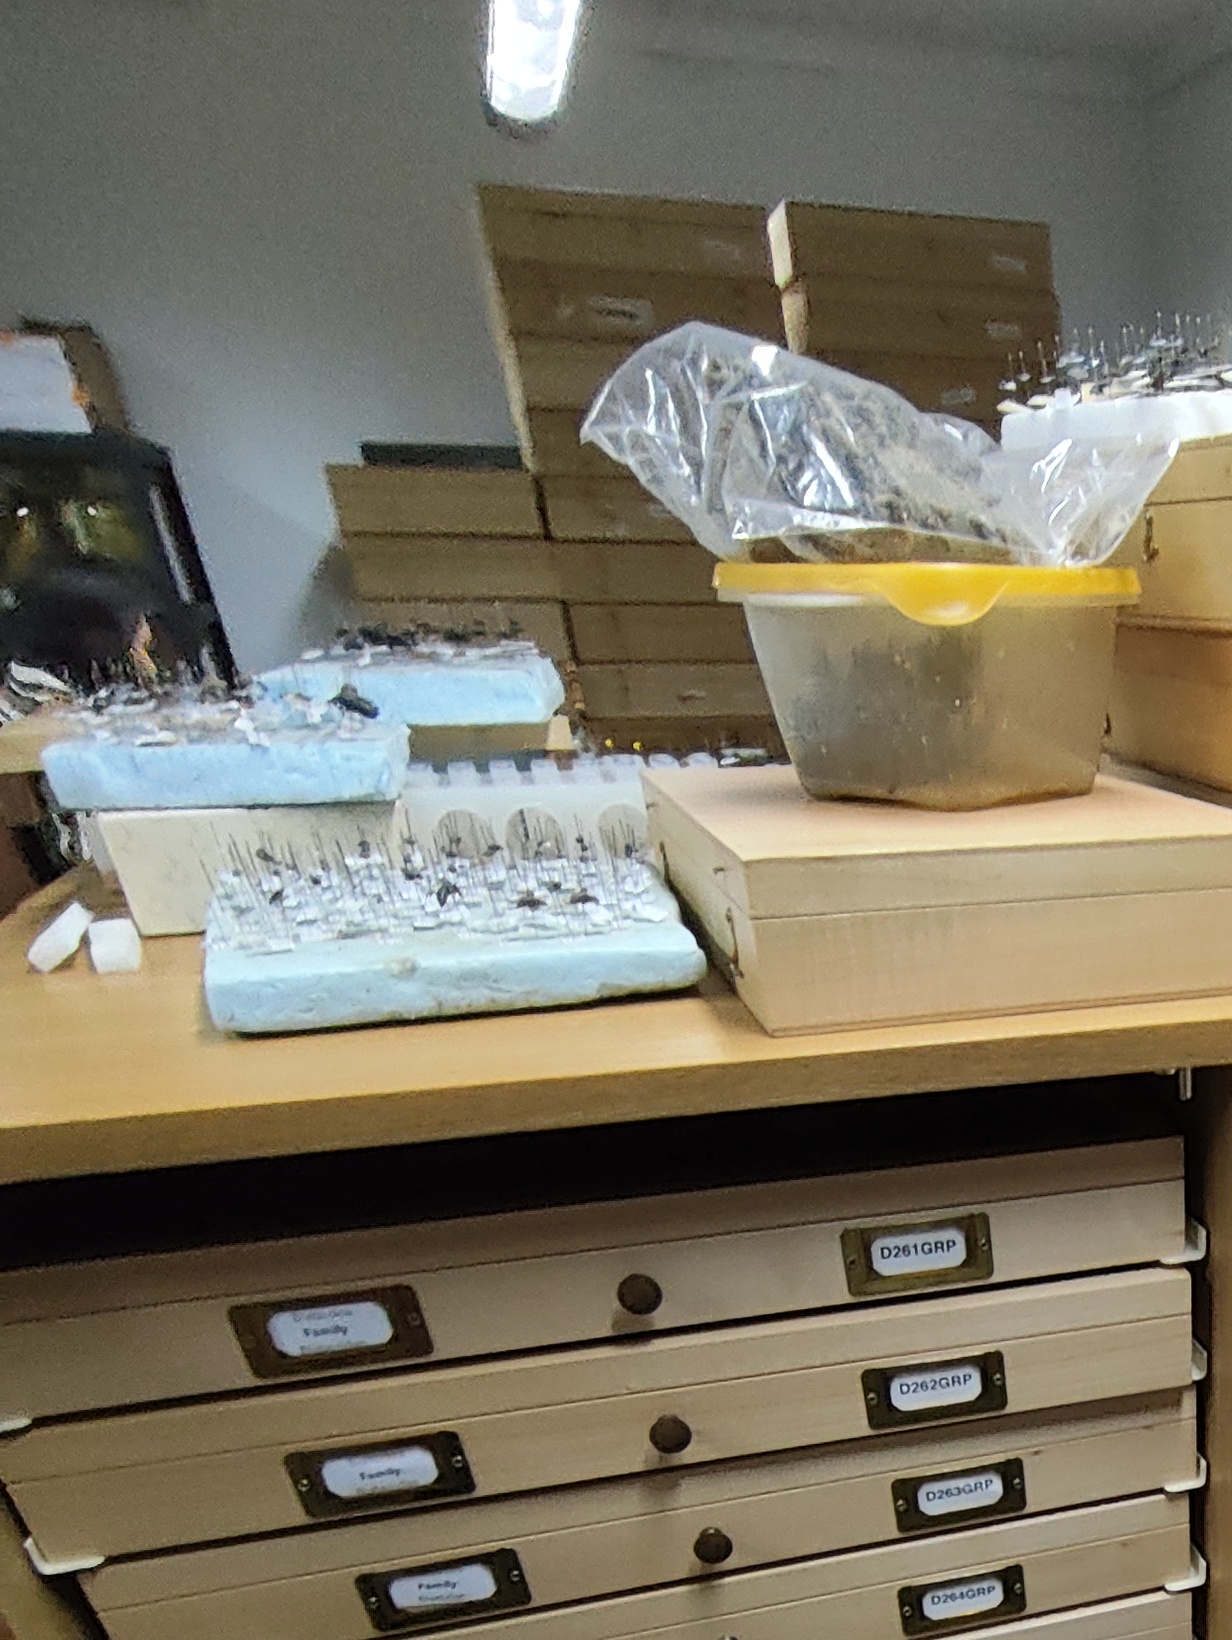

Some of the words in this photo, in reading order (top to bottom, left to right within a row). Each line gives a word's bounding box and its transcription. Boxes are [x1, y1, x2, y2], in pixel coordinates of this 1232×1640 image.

[879, 1238, 957, 1260] D261GRP
[303, 1324, 348, 1338] Family
[899, 1372, 973, 1396] D262GRP
[359, 1467, 401, 1481] Family
[925, 1478, 994, 1502] D263GRP
[417, 1580, 458, 1591] Family
[930, 1585, 996, 1605] D264GRP
